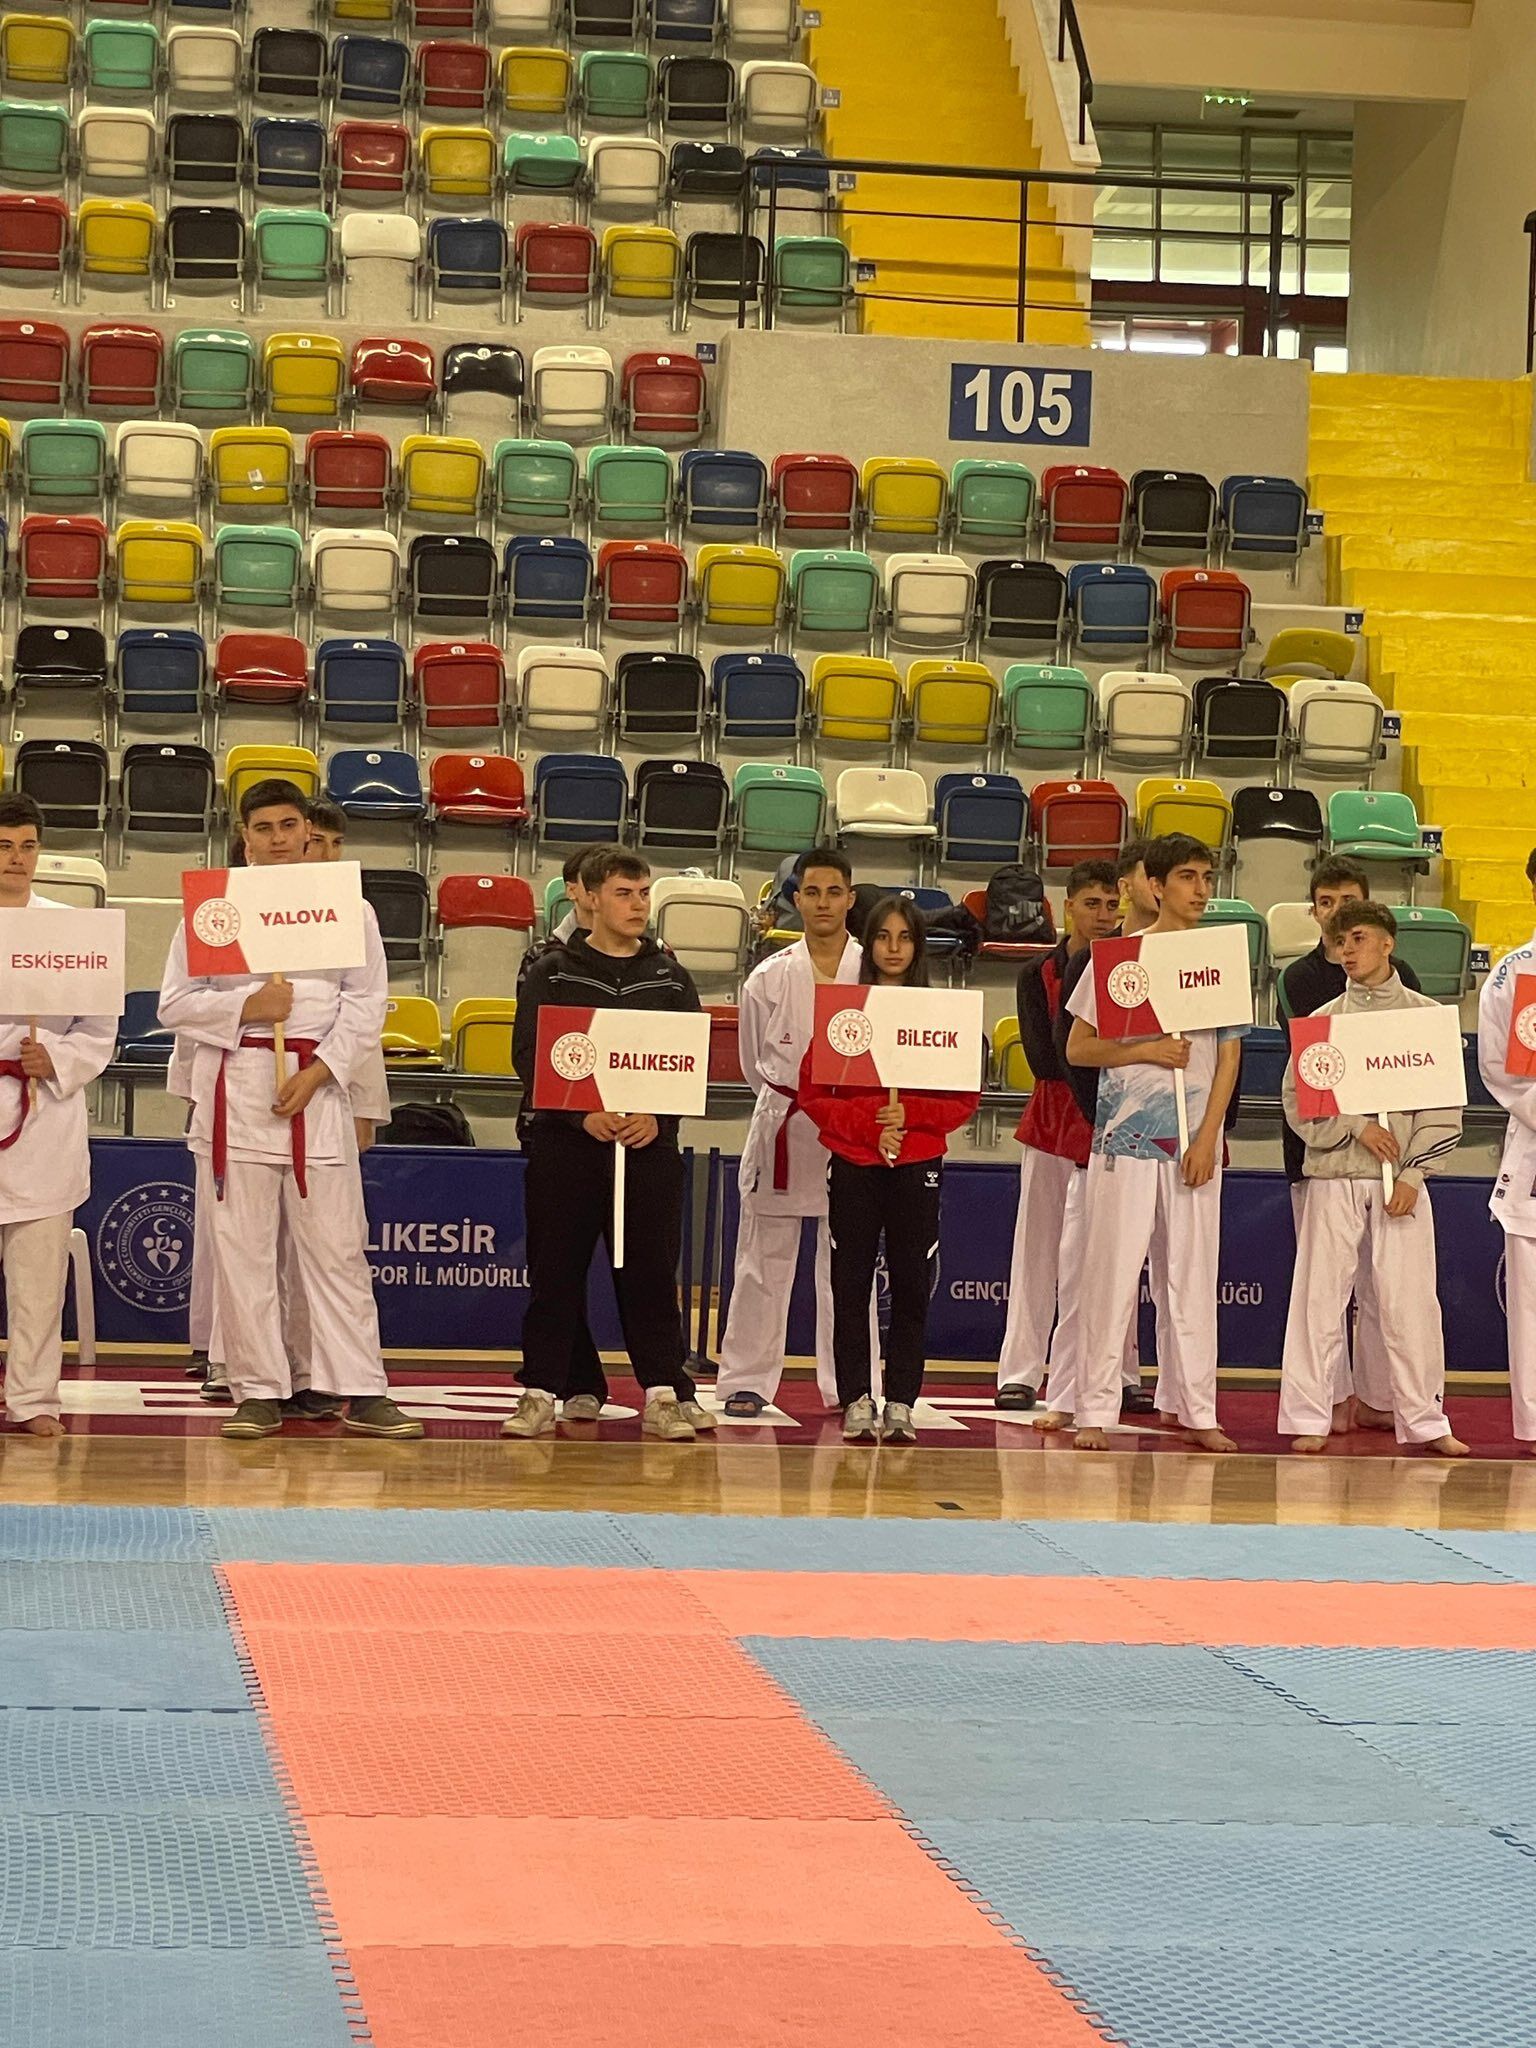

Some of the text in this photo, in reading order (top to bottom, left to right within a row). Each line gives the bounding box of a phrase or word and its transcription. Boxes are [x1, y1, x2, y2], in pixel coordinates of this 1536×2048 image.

[964, 369, 1072, 436] 105
[259, 908, 338, 926] YALOVA
[11, 950, 108, 972] ESKİŞEHİR
[1493, 950, 1533, 989] MOOTO
[1178, 966, 1221, 989] İZMİR
[1365, 1050, 1435, 1071] MANİSA
[364, 1217, 496, 1254] LIKESİR
[370, 1265, 409, 1286] POR
[415, 1262, 432, 1286] İL
[950, 1280, 1010, 1306] GENÇL
